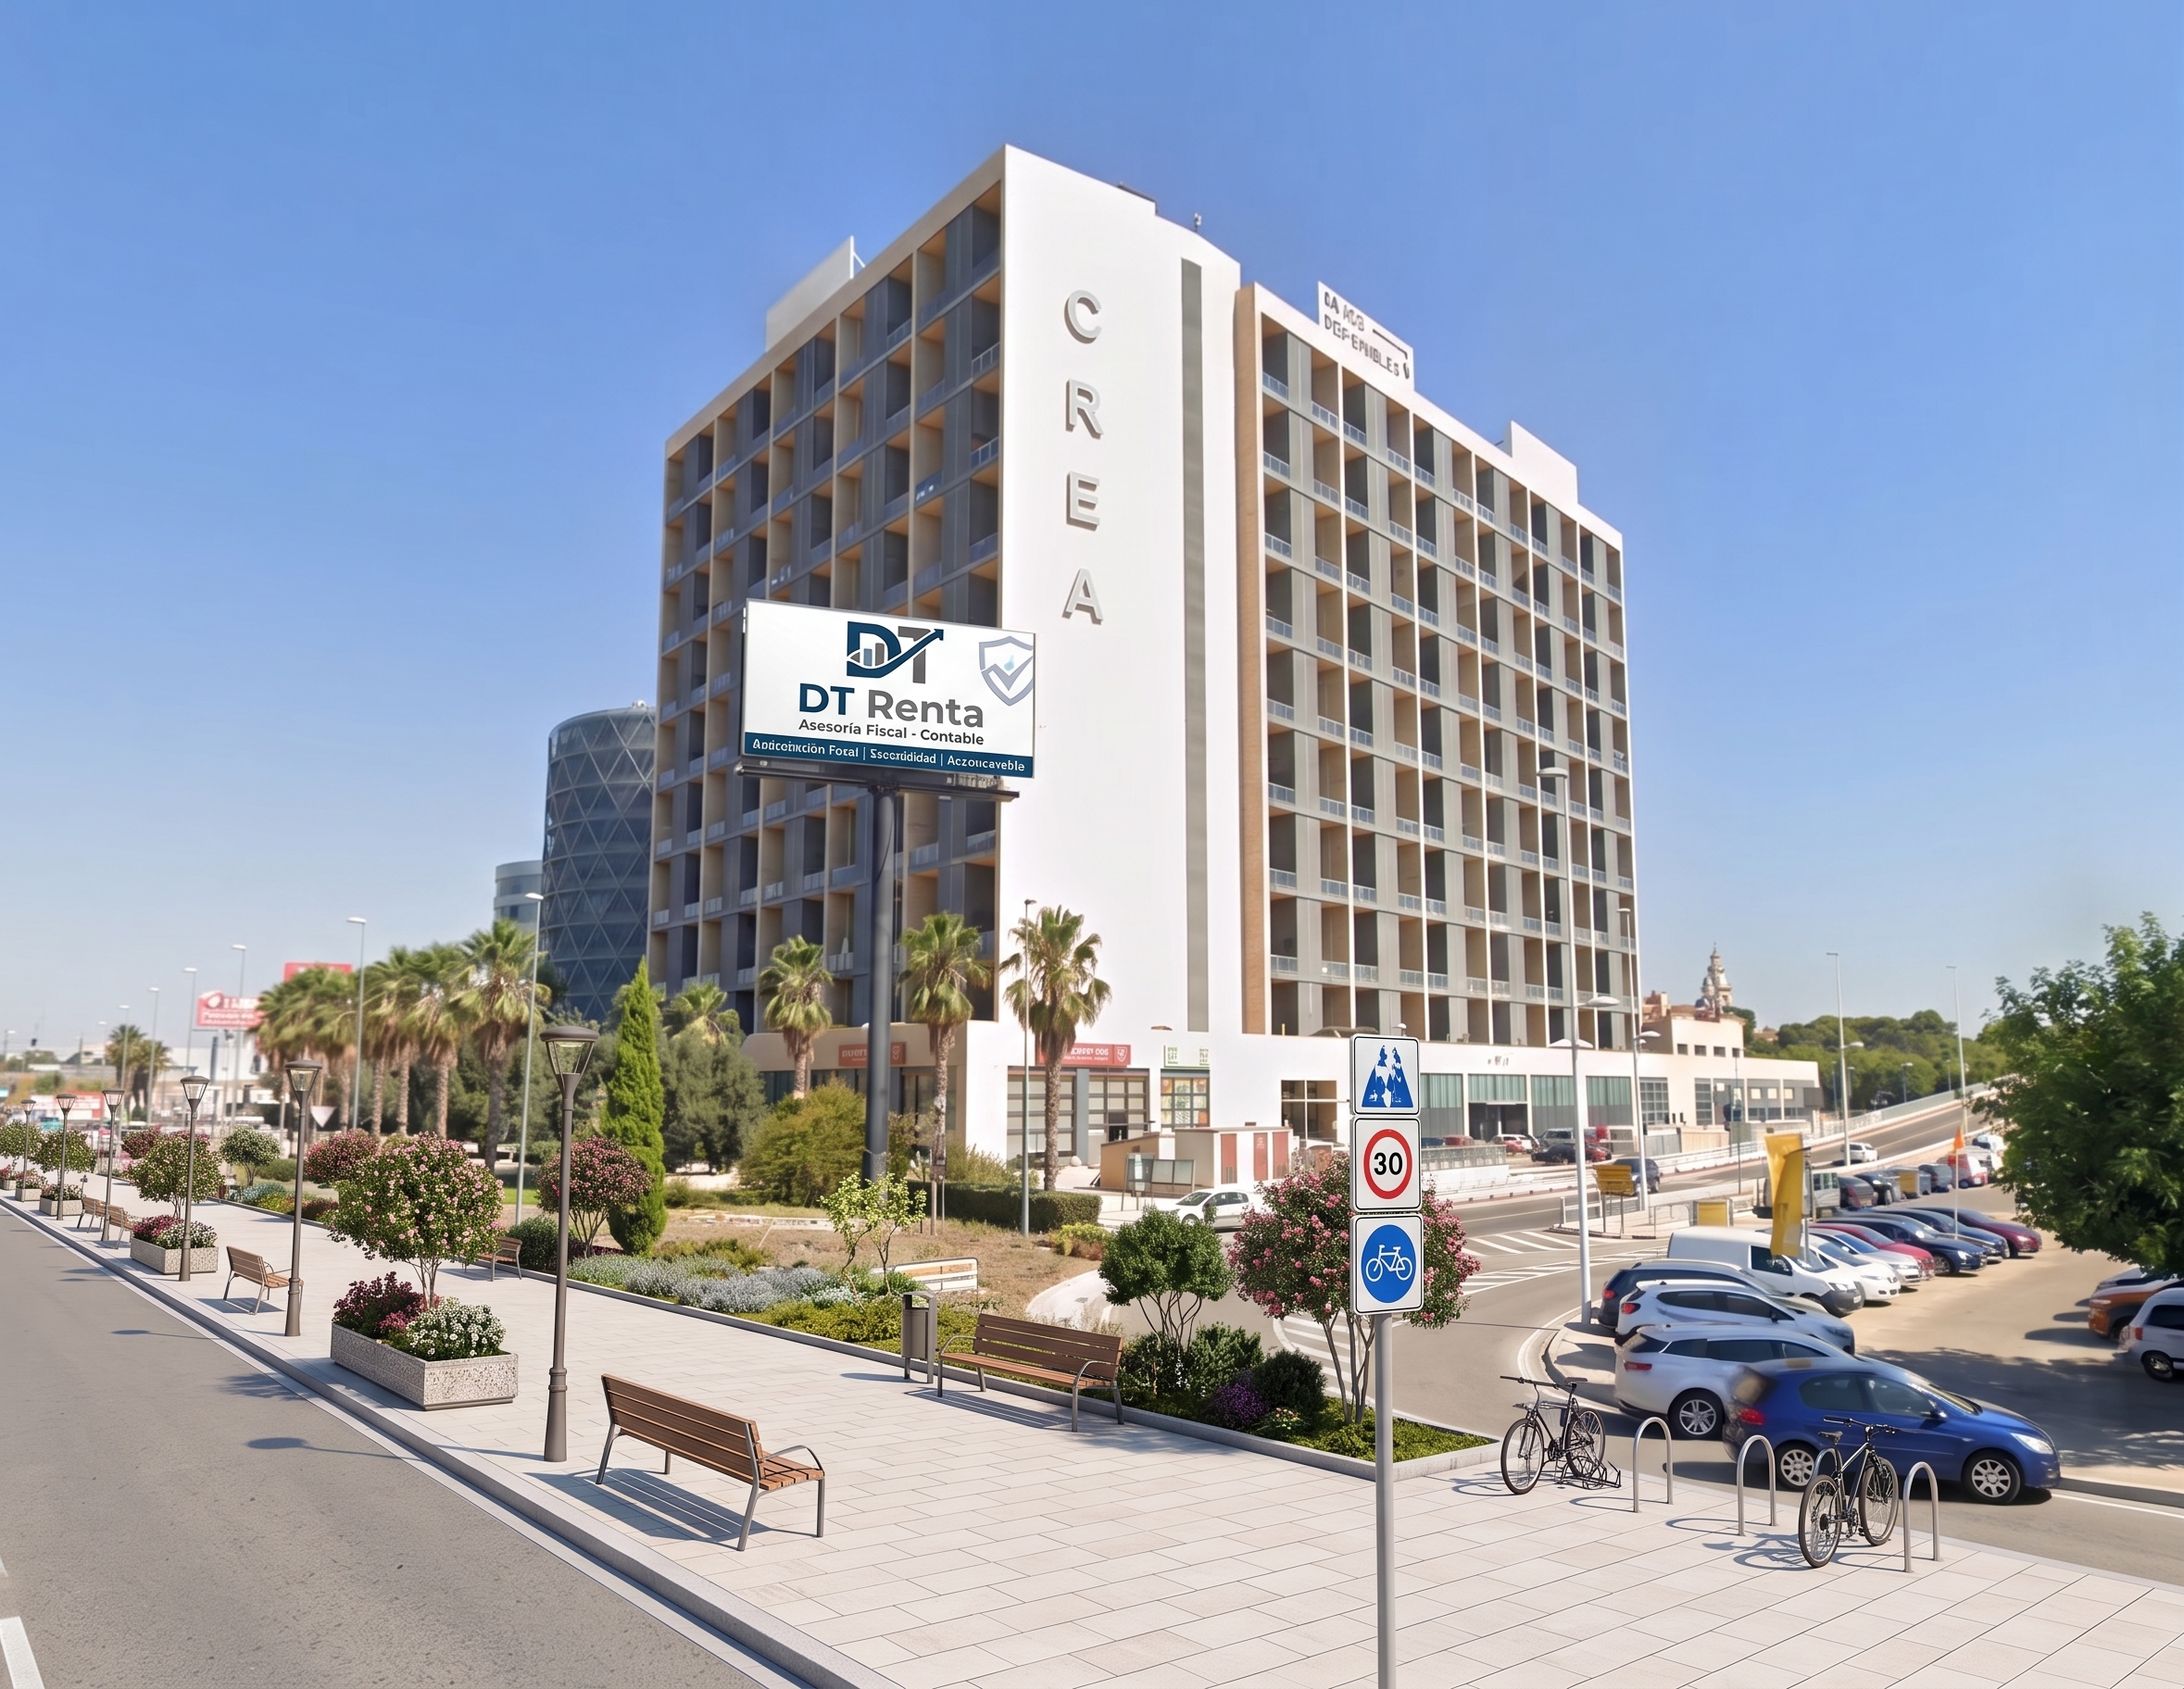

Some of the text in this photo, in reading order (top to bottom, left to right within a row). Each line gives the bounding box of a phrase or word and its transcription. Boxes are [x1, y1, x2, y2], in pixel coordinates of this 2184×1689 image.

[1062, 289, 1105, 626] CREA
[799, 682, 984, 728] DT Renta
[798, 719, 861, 734] Asesoría
[866, 724, 907, 738] Fiscal
[920, 729, 985, 745] Contable
[1374, 1152, 1403, 1175] 30
